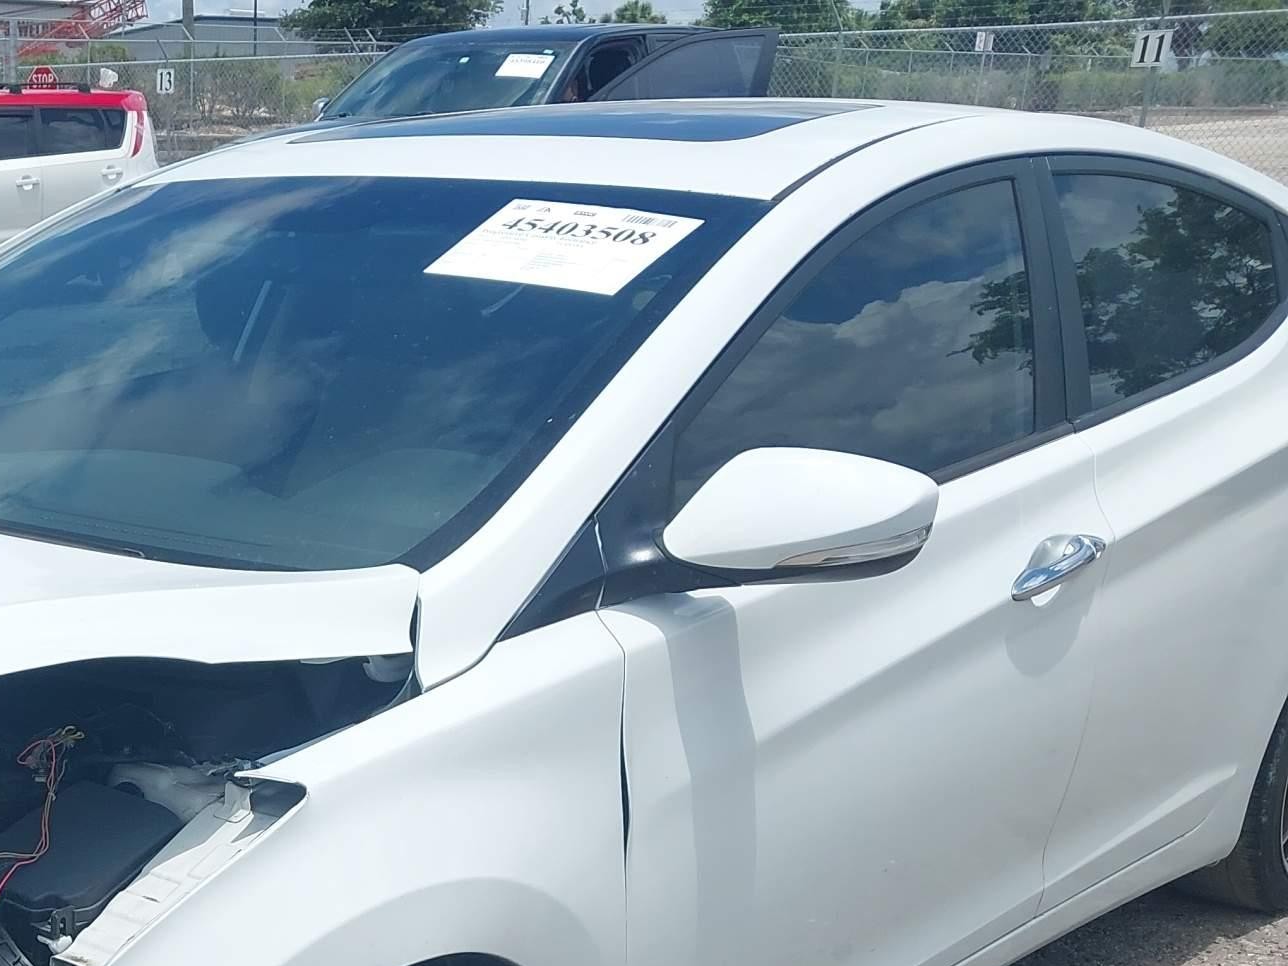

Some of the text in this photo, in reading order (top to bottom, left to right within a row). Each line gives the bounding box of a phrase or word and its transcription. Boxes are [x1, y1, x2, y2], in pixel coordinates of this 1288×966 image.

[1136, 33, 1165, 63] 11
[32, 73, 54, 88] STOP
[158, 71, 173, 92] 13
[501, 216, 657, 246] 45403508
